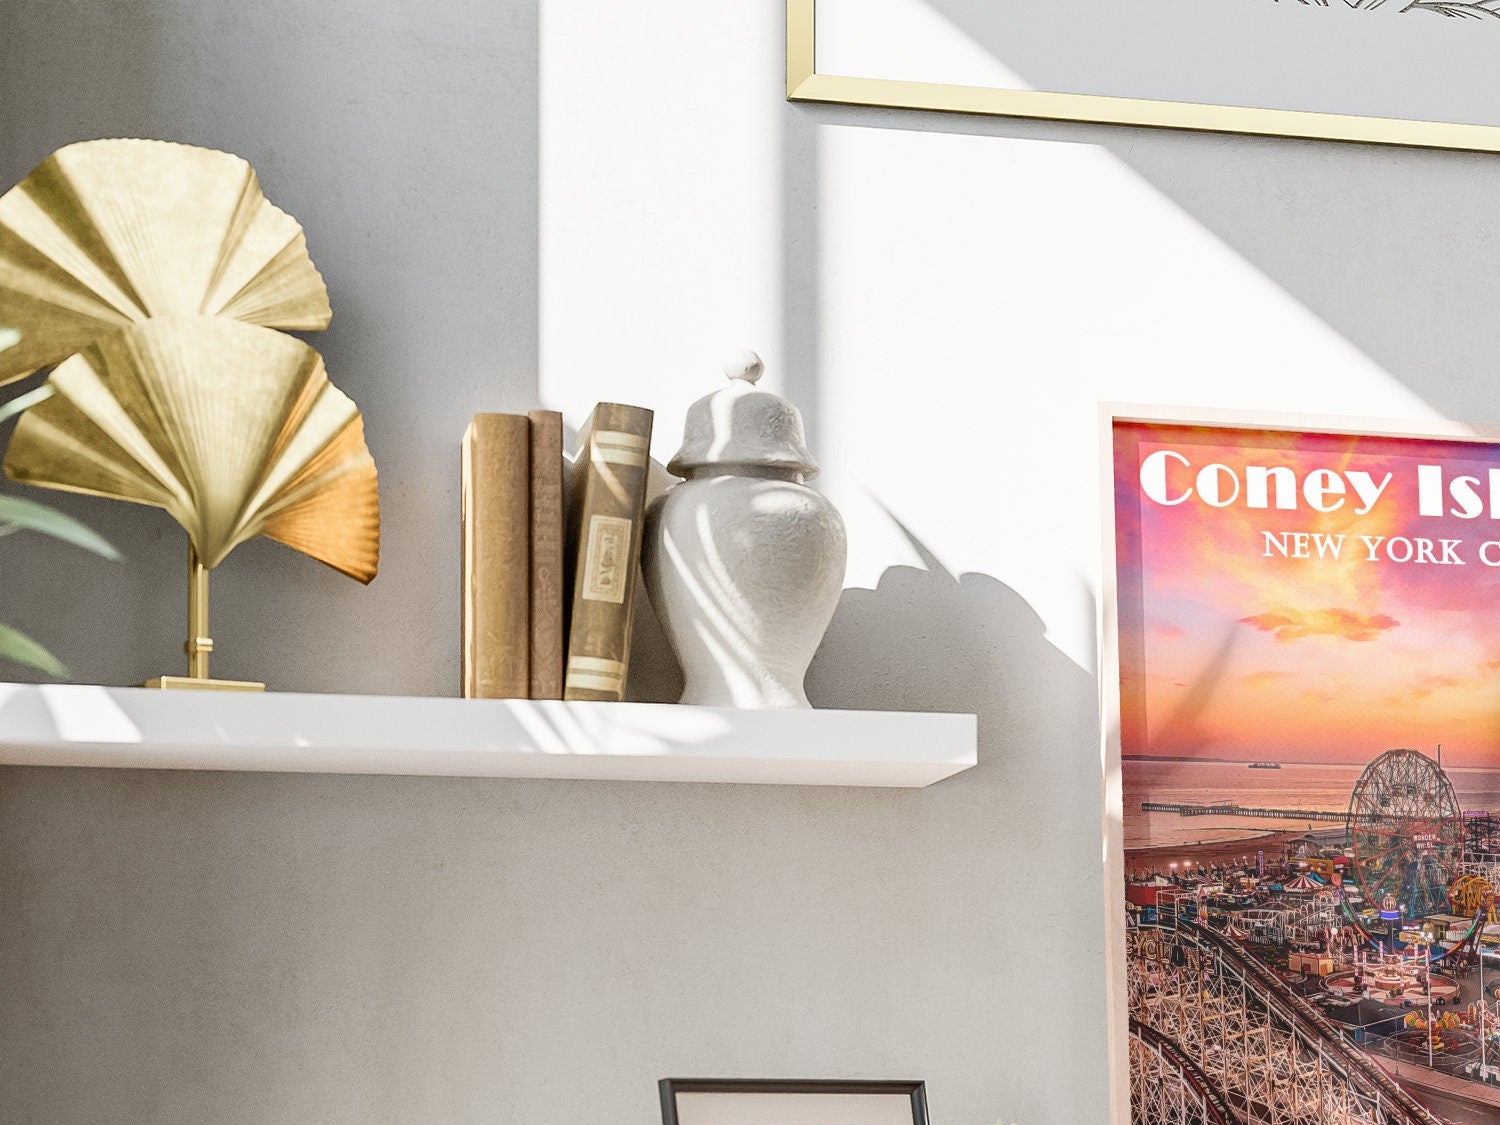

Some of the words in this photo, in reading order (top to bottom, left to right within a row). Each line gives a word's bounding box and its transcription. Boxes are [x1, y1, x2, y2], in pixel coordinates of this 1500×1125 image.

[1139, 450, 1393, 515] Coney
[1260, 530, 1347, 560] NEW
[1358, 535, 1466, 566] YORK
